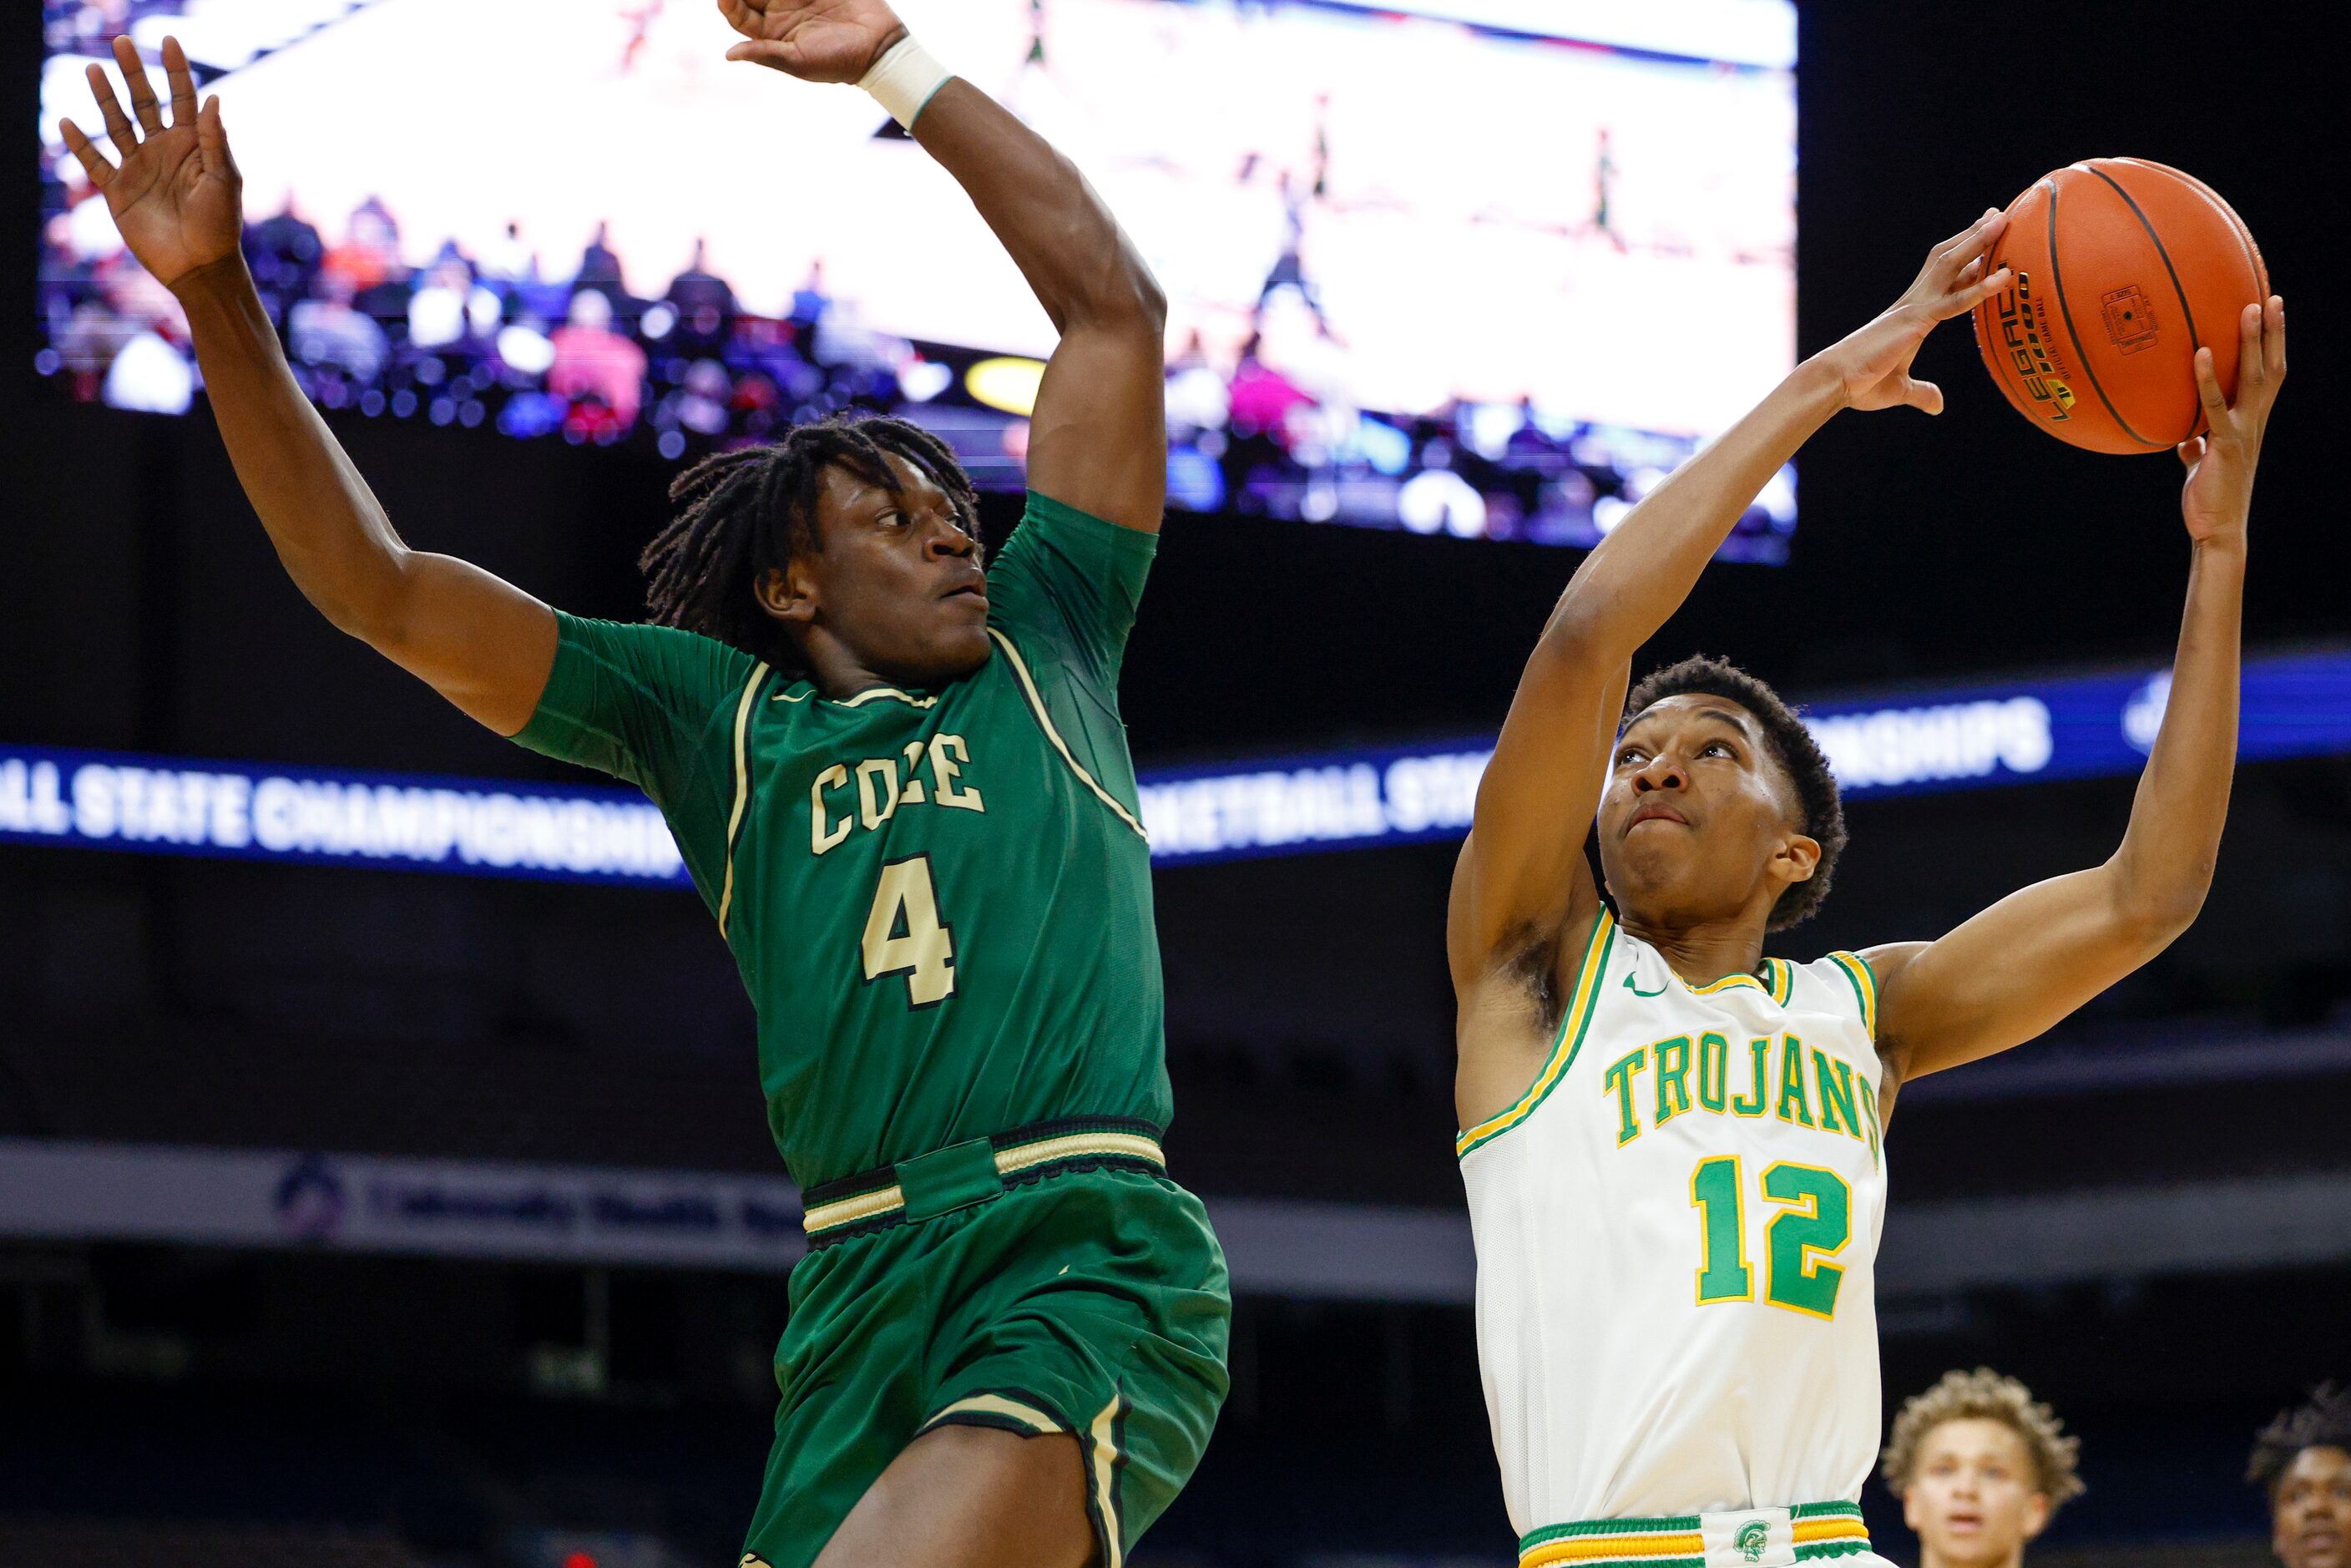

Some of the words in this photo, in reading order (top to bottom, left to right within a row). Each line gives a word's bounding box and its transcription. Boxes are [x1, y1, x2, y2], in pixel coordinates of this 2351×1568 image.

[1997, 260, 2070, 421] LEGAC
[2019, 272, 2055, 375] 1000
[2035, 296, 2045, 318] BALL
[2040, 321, 2053, 343] GAME
[2049, 346, 2070, 380] OFFICIAL
[0, 758, 68, 833] LL
[73, 763, 250, 847] STATE
[810, 731, 985, 856] COLE
[859, 851, 959, 1012] 4
[1603, 1030, 1880, 1176] TROJANS
[1689, 1154, 1853, 1323] 12
